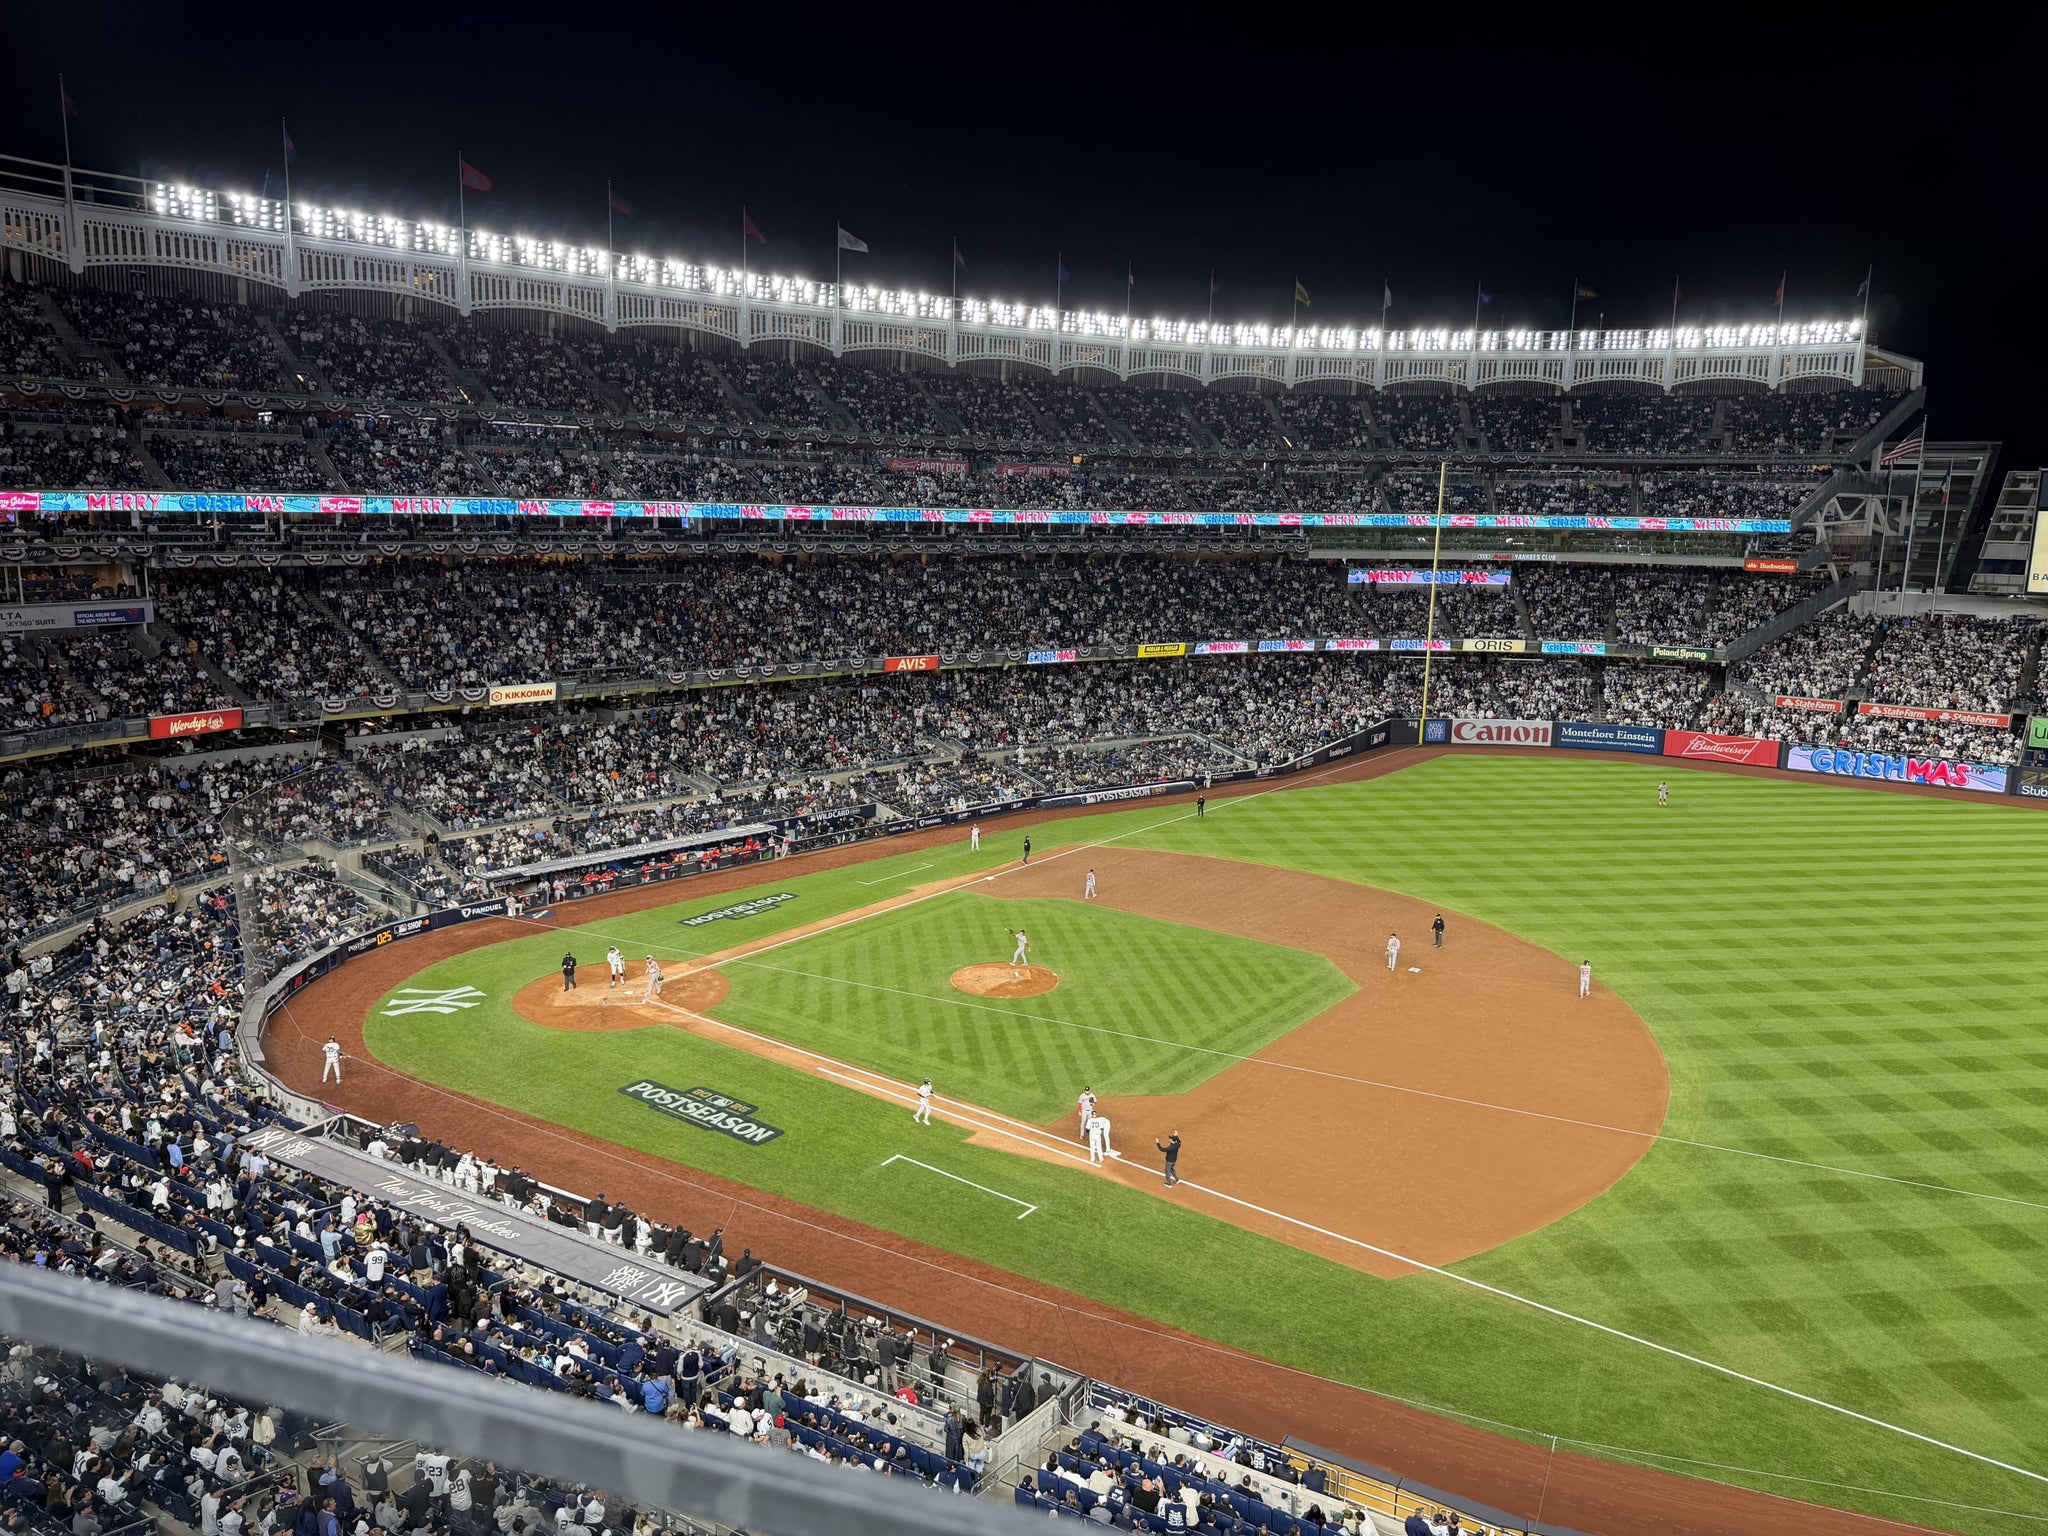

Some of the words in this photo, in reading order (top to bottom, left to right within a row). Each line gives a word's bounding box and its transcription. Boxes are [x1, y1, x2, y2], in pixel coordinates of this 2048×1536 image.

[920, 462, 945, 472] PARTY
[946, 463, 966, 472] DECK
[88, 493, 164, 511] MERRY
[180, 494, 286, 512] GRISHMAS
[393, 498, 455, 513] MERRY
[468, 499, 550, 515] GRISHMAS
[644, 503, 691, 517] MERRY
[702, 504, 765, 518] GRISHMAS
[833, 507, 876, 520] MERRY
[886, 509, 945, 522] GRISHMAS
[1015, 512, 1051, 523] MERRY
[1059, 513, 1109, 524] GRISHMAS
[1163, 514, 1197, 524] MERRY
[1204, 514, 1255, 525] GRISHMAS
[1324, 515, 1363, 525] MERRY
[1695, 520, 1740, 531] MERRY
[1759, 562, 1796, 571] Budweiser
[1368, 570, 1414, 583] MERRY
[1474, 640, 1513, 651] ORIS
[1547, 644, 1597, 653] GRISHMAS
[1653, 647, 1679, 657] Poland
[1680, 648, 1707, 660] Spring
[897, 658, 926, 670] AVIS
[505, 689, 553, 700] KIKKOMAN
[169, 717, 206, 735] Wendy's
[1453, 721, 1549, 743] Canon
[1561, 727, 1615, 739] Montefiore
[1616, 730, 1656, 742] Einstein
[1690, 739, 1751, 755] Budweiser
[1811, 749, 1971, 786] GRISHMAS
[1096, 787, 1151, 802] POSTSEASON
[816, 812, 833, 821] WILD
[832, 809, 850, 818] CARD
[472, 903, 503, 915] FANDUEL
[683, 893, 795, 927] POSTSEASON
[407, 920, 423, 931] SHOP
[347, 936, 377, 952] POSTSEASON
[625, 1081, 775, 1142] POSTSEASON
[374, 1175, 414, 1198] New
[396, 1189, 451, 1213] York
[437, 1200, 520, 1239] Yankees
[371, 1256, 383, 1265] 99
[607, 1269, 644, 1288] YORK
[615, 1265, 649, 1280] NEW
[600, 1277, 628, 1292] LIFE
[230, 1422, 243, 1434] 99
[428, 1466, 443, 1477] 23
[449, 1478, 466, 1494] 28
